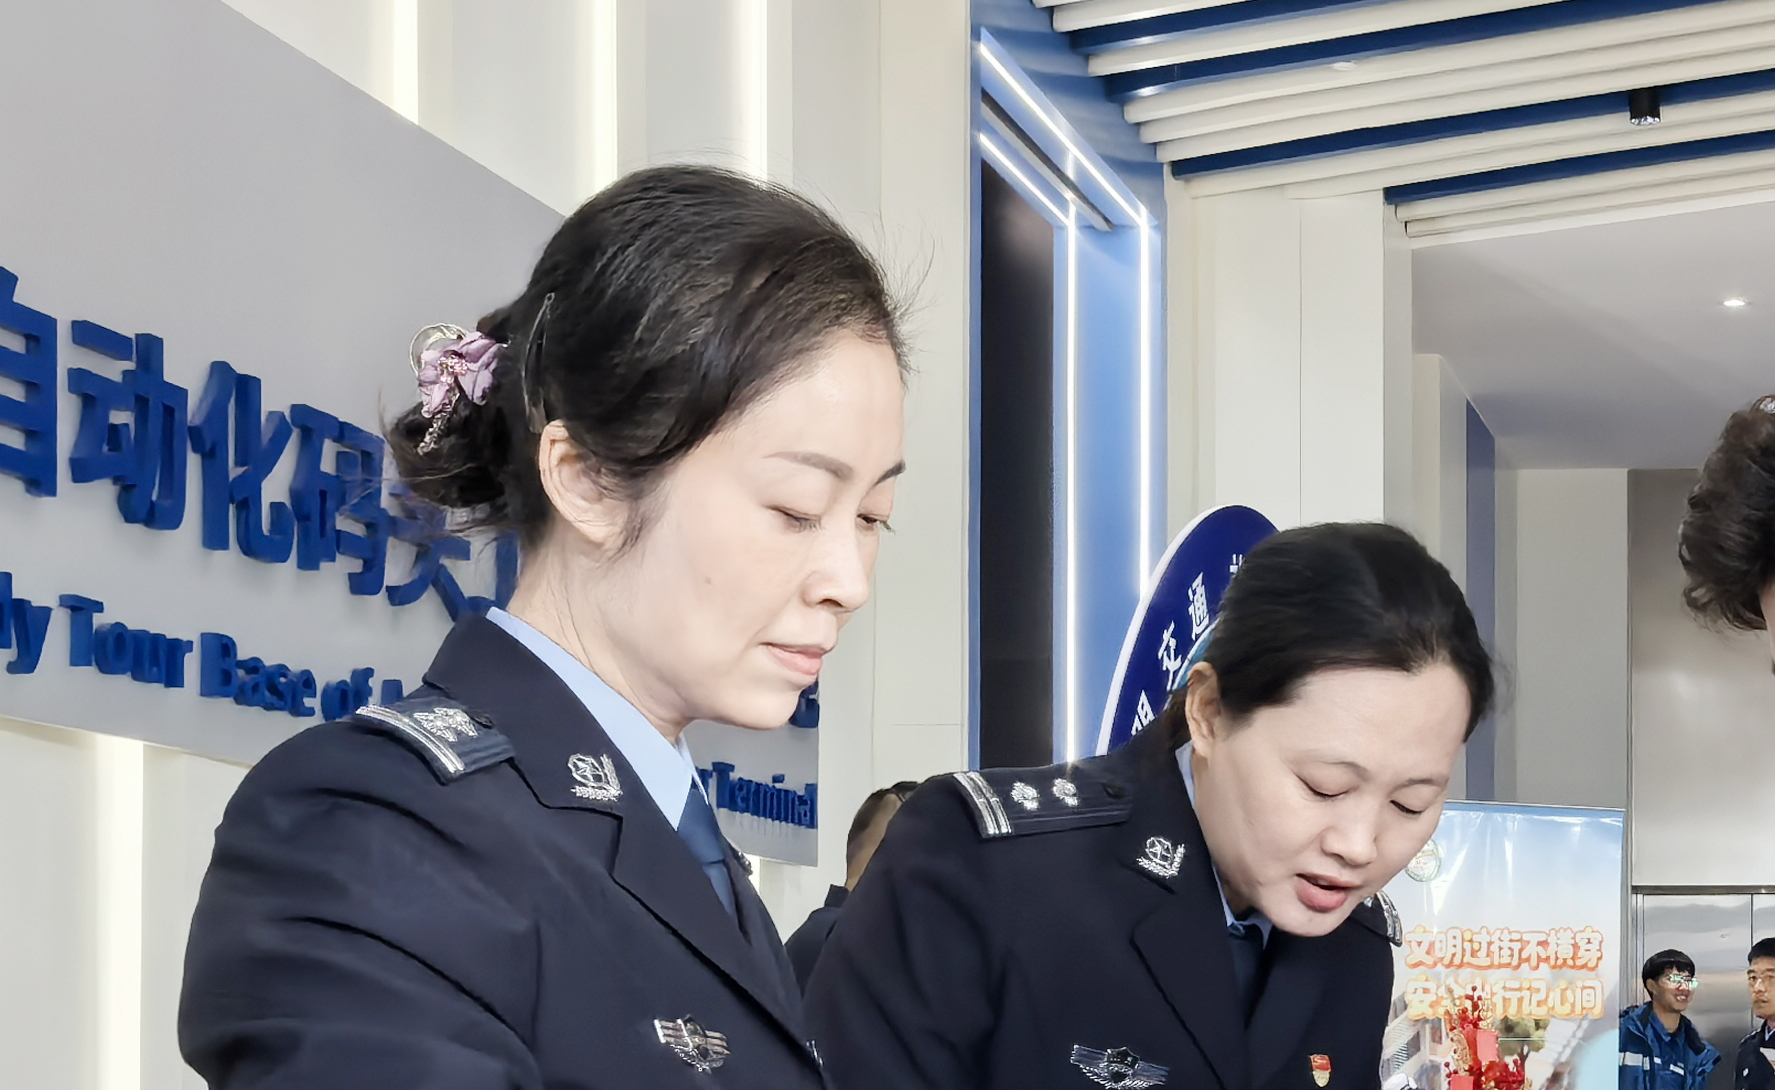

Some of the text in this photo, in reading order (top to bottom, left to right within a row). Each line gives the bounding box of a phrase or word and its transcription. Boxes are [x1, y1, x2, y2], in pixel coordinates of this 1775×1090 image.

[0, 266, 519, 622] 自动化码头
[59, 594, 193, 689] Tour
[200, 632, 316, 717] Base
[321, 667, 374, 722] of
[712, 761, 818, 830] Terminal
[1404, 925, 1604, 970] 文明过街不横穿
